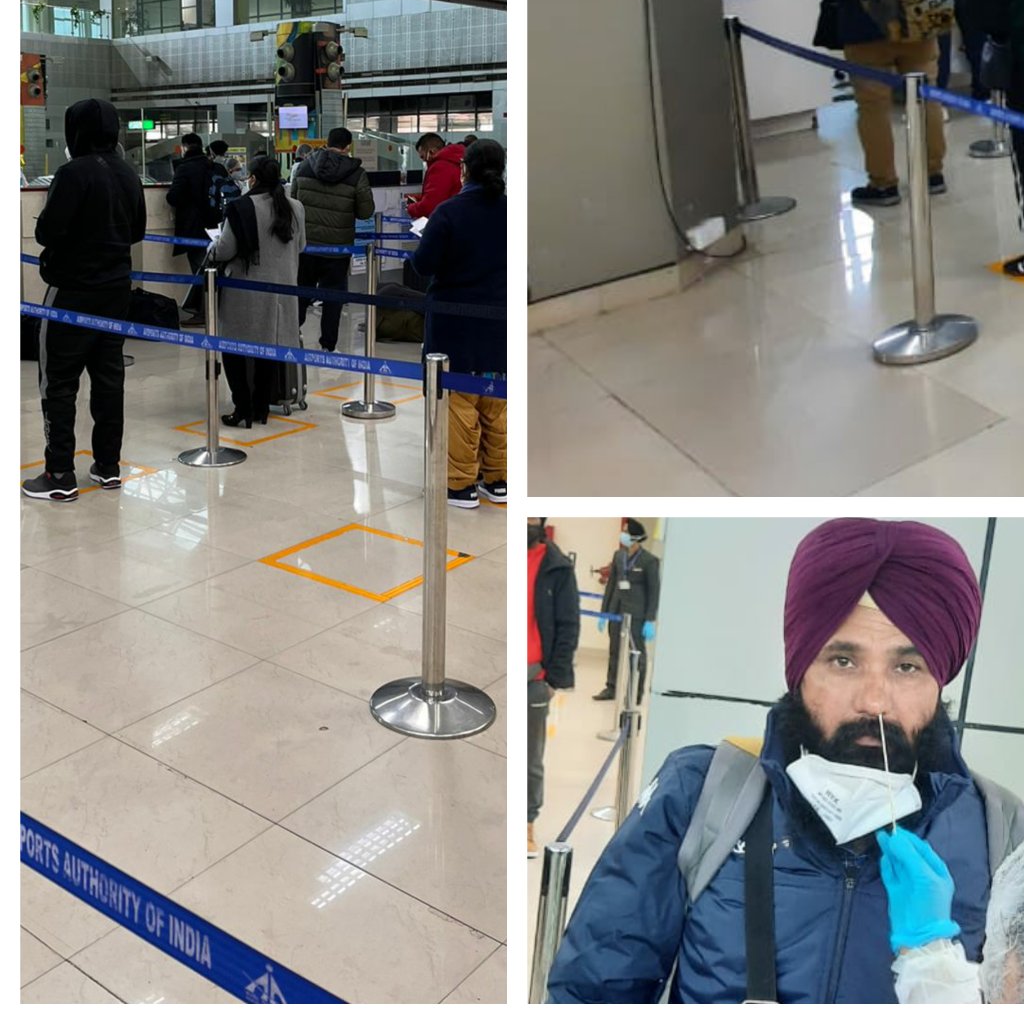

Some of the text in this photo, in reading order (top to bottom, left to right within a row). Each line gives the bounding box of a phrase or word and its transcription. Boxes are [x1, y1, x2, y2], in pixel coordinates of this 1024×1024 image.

[20, 824, 212, 970] PORTS AUTHORITY OF INDIA
